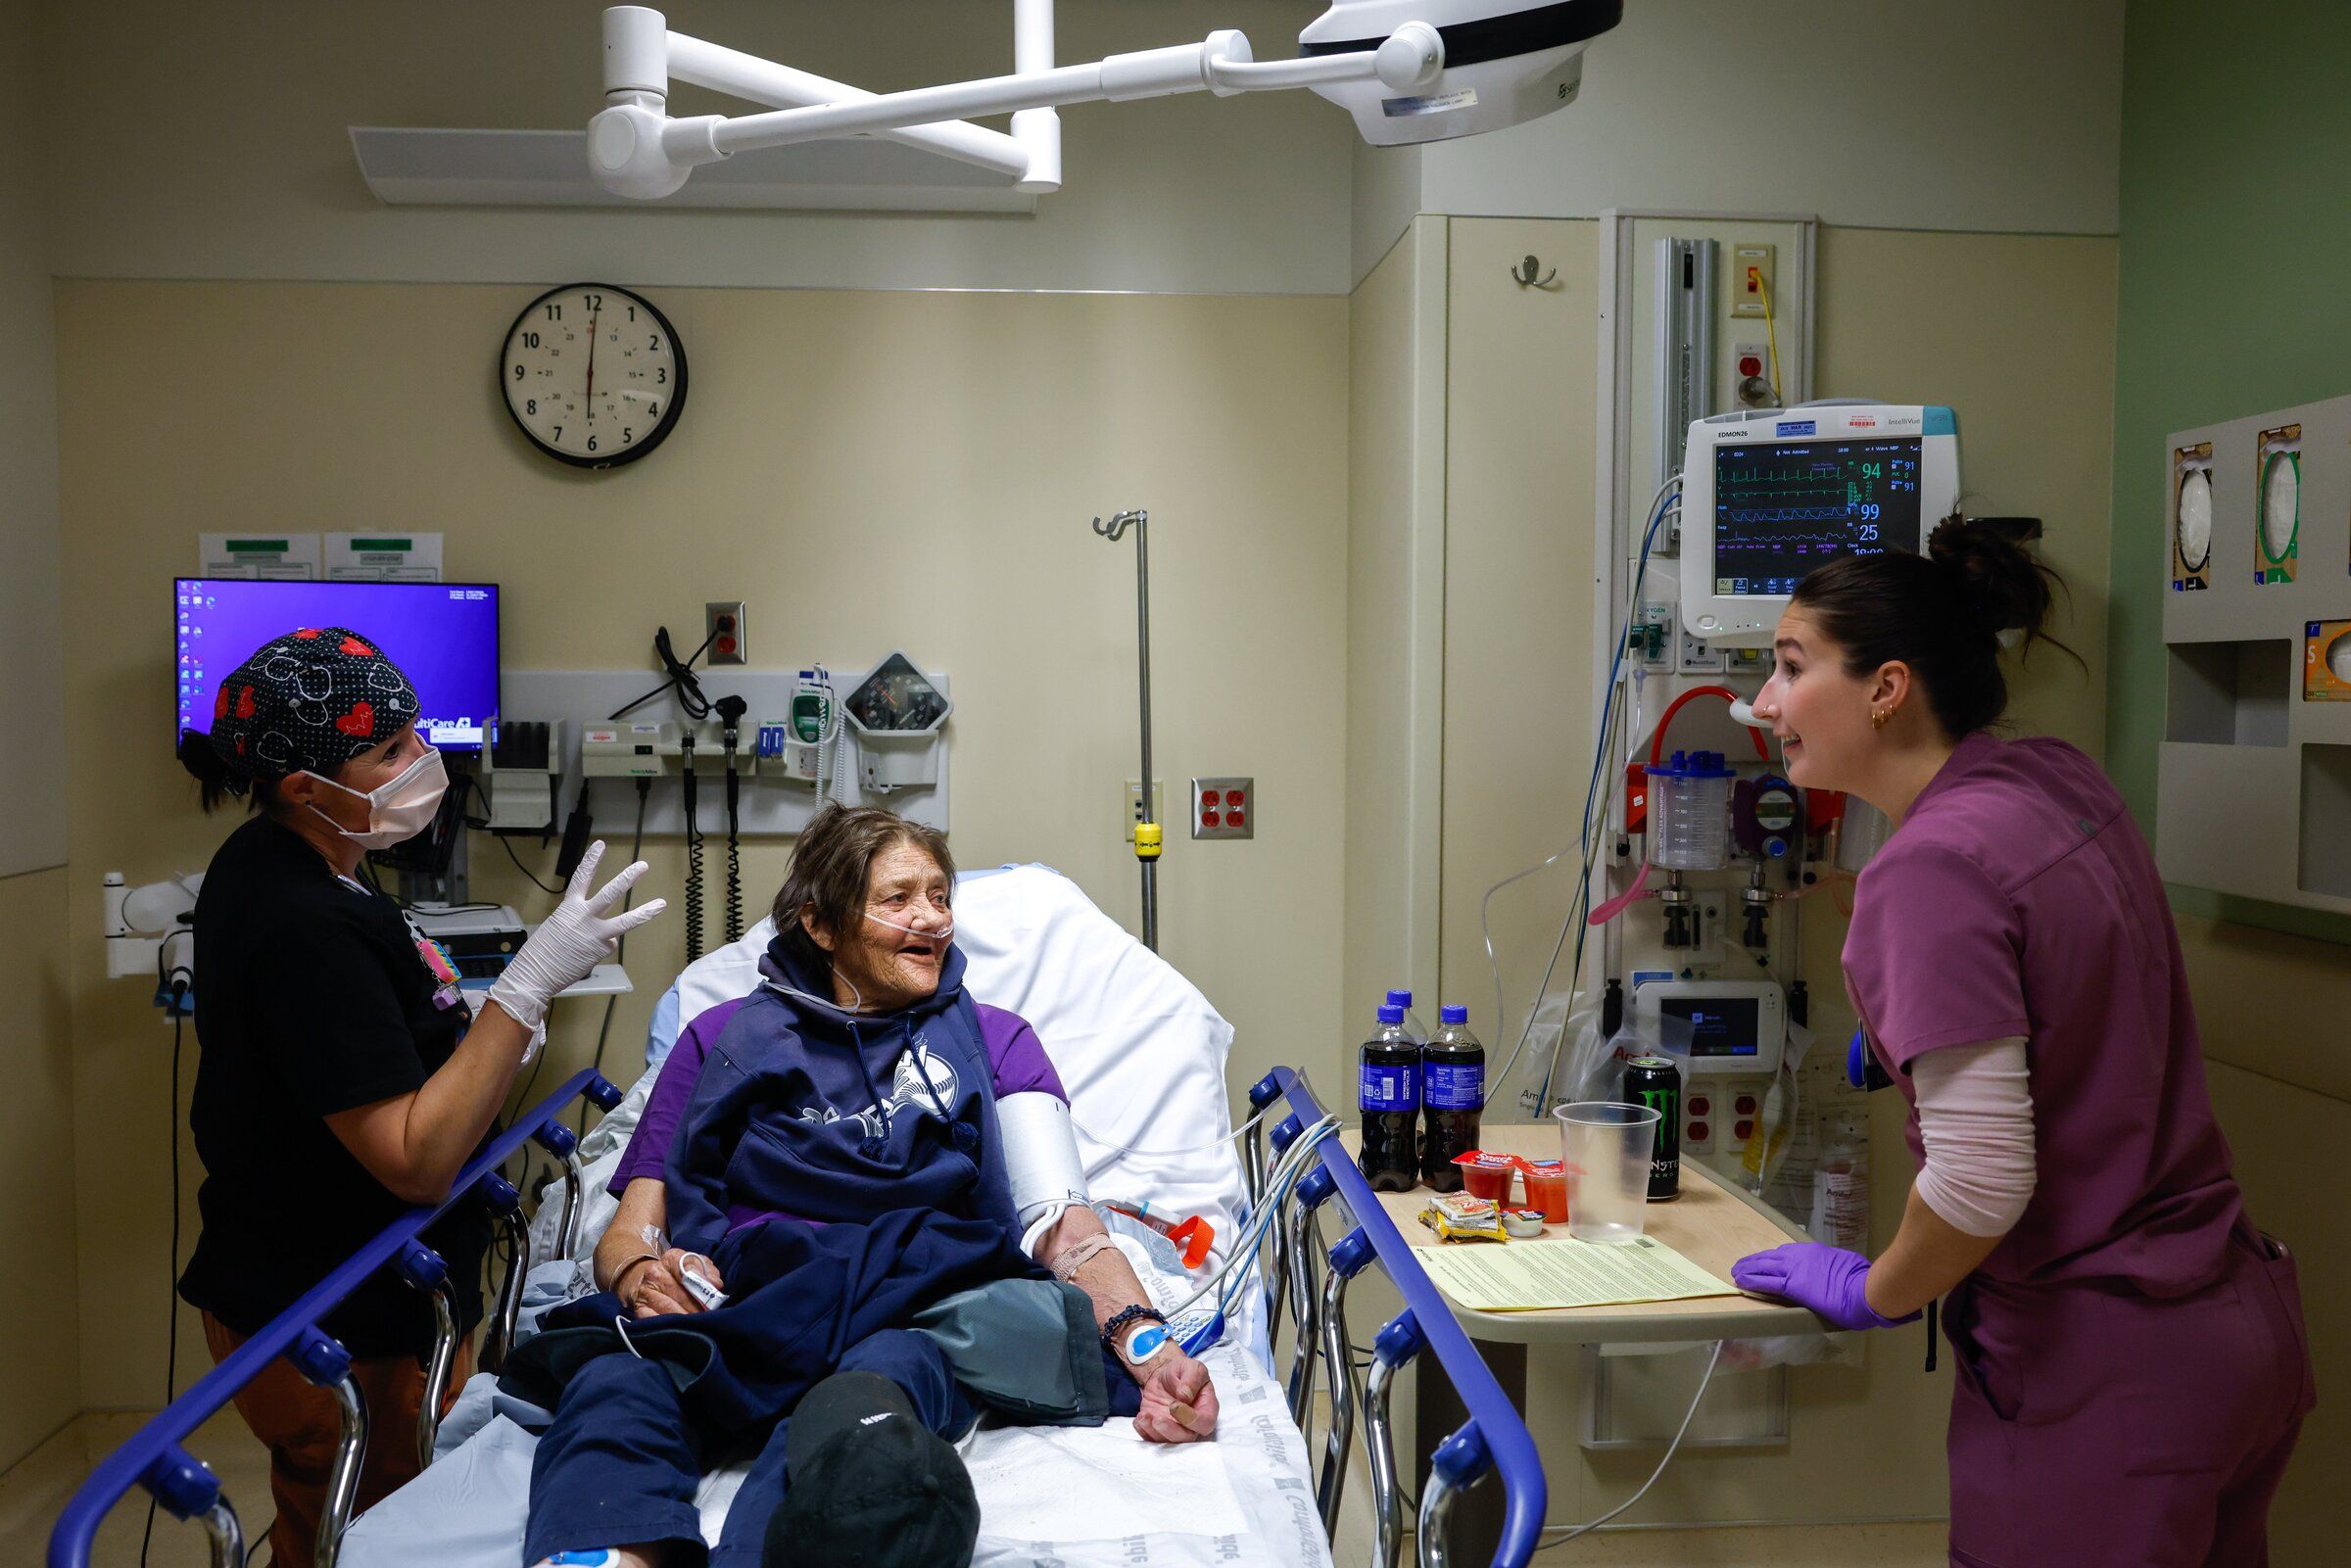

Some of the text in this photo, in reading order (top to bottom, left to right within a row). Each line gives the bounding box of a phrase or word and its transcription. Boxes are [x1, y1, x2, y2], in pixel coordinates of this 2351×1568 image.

[584, 296, 601, 311] 12
[546, 305, 561, 320] 11
[628, 307, 635, 321] 1
[522, 333, 540, 349] 10
[649, 335, 658, 351] 2
[515, 365, 525, 380] 9
[657, 368, 666, 383] 3
[527, 400, 536, 414] 8
[648, 403, 658, 417] 4
[1888, 417, 1921, 426] IntelliVue
[553, 427, 562, 442] 7
[623, 428, 632, 443] 5
[588, 436, 597, 451] 6
[1862, 462, 1881, 479] 94
[1904, 461, 1914, 470] 91
[1904, 482, 1914, 492] 91
[1861, 503, 1880, 520] 99
[1859, 524, 1878, 541] 25
[2308, 644, 2316, 664] S
[414, 718, 455, 729] ultiCare
